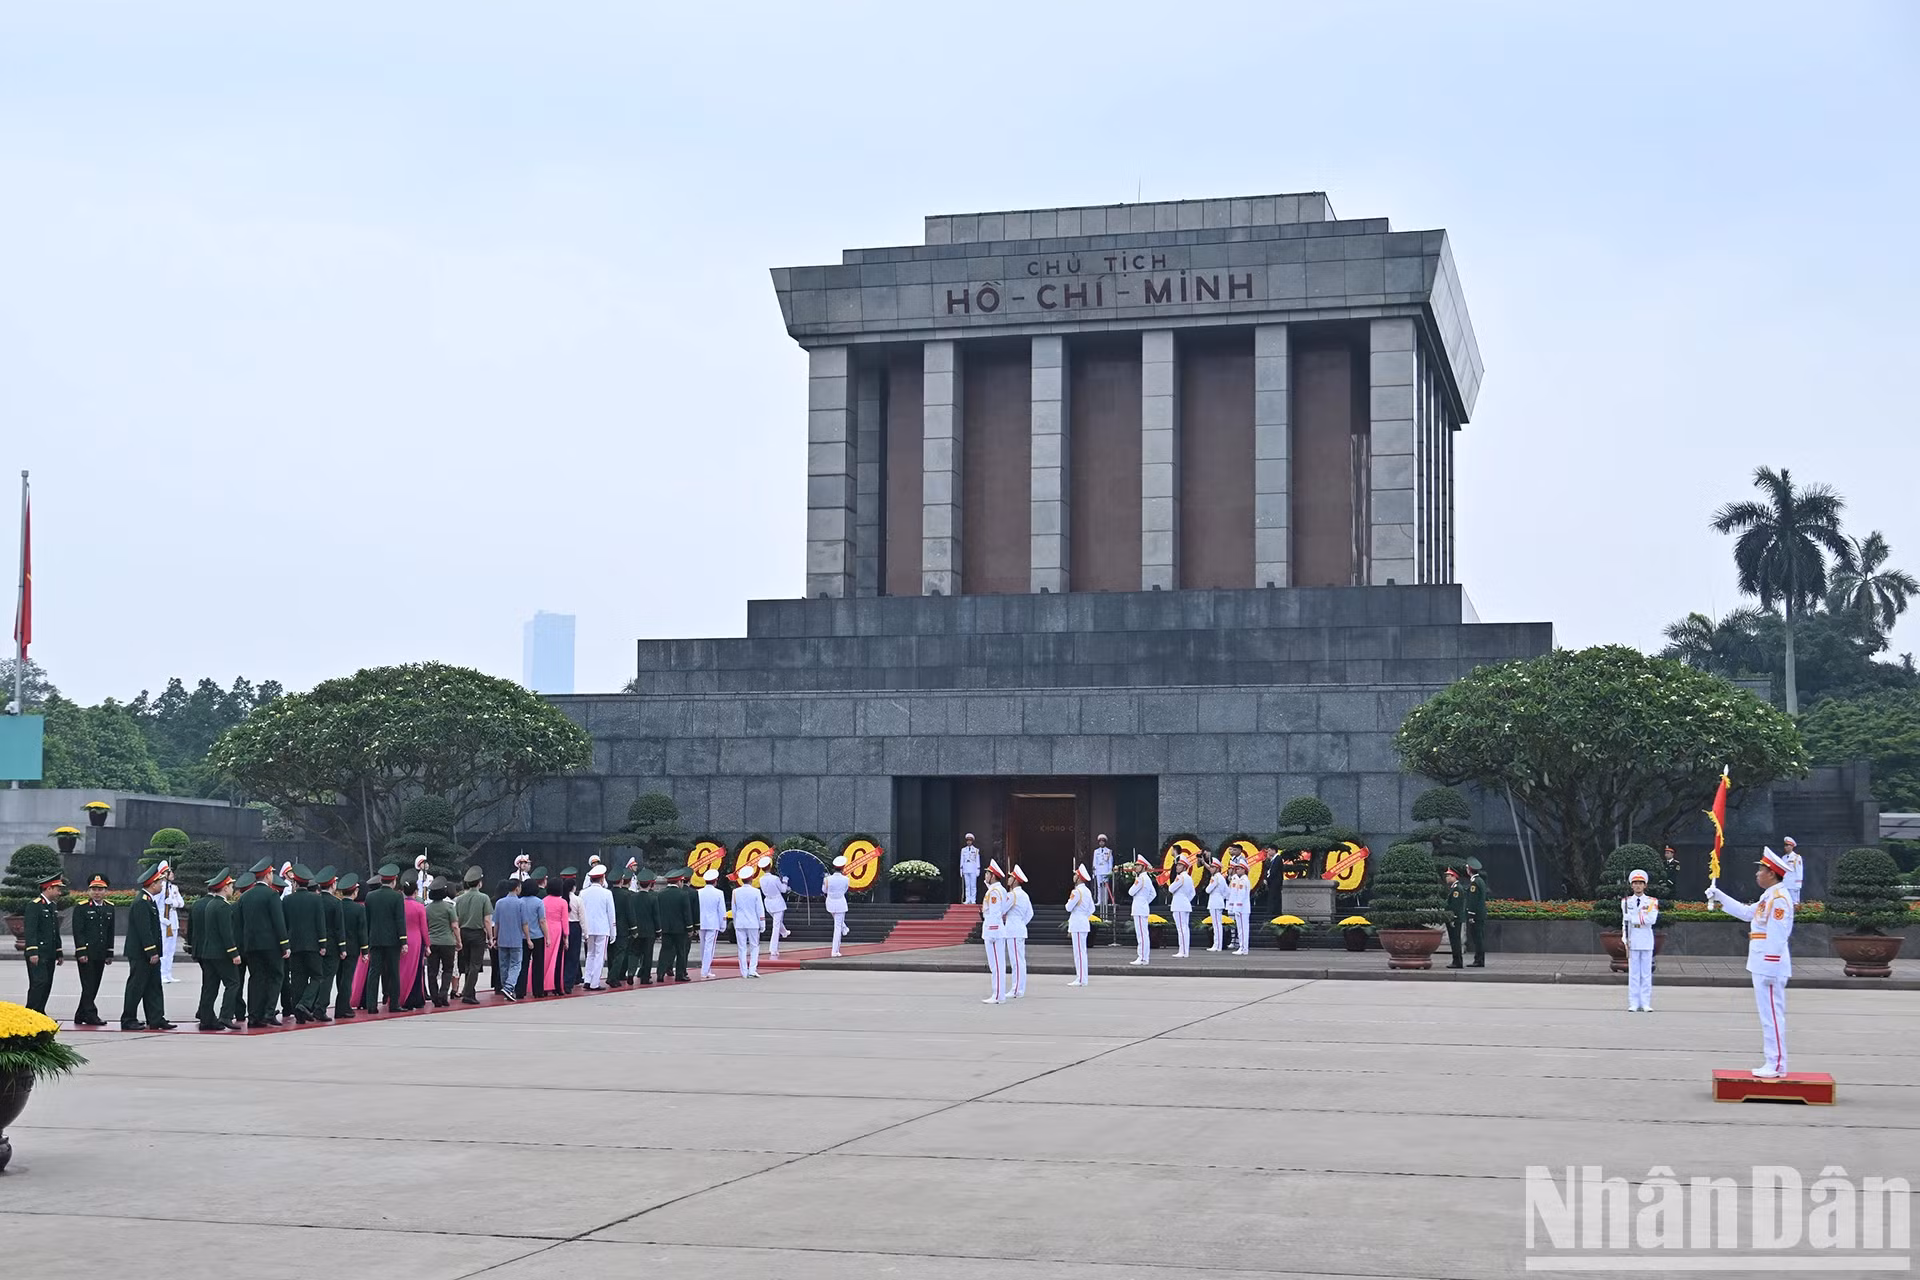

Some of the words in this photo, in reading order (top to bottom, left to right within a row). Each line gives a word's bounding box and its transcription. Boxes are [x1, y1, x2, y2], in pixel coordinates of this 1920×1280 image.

[1027, 252, 1081, 276] CHỦ
[1103, 251, 1166, 277] TỊCH
[947, 281, 1002, 314] HỒ
[1037, 274, 1106, 309] CHÍ
[1144, 269, 1254, 304] MINH
